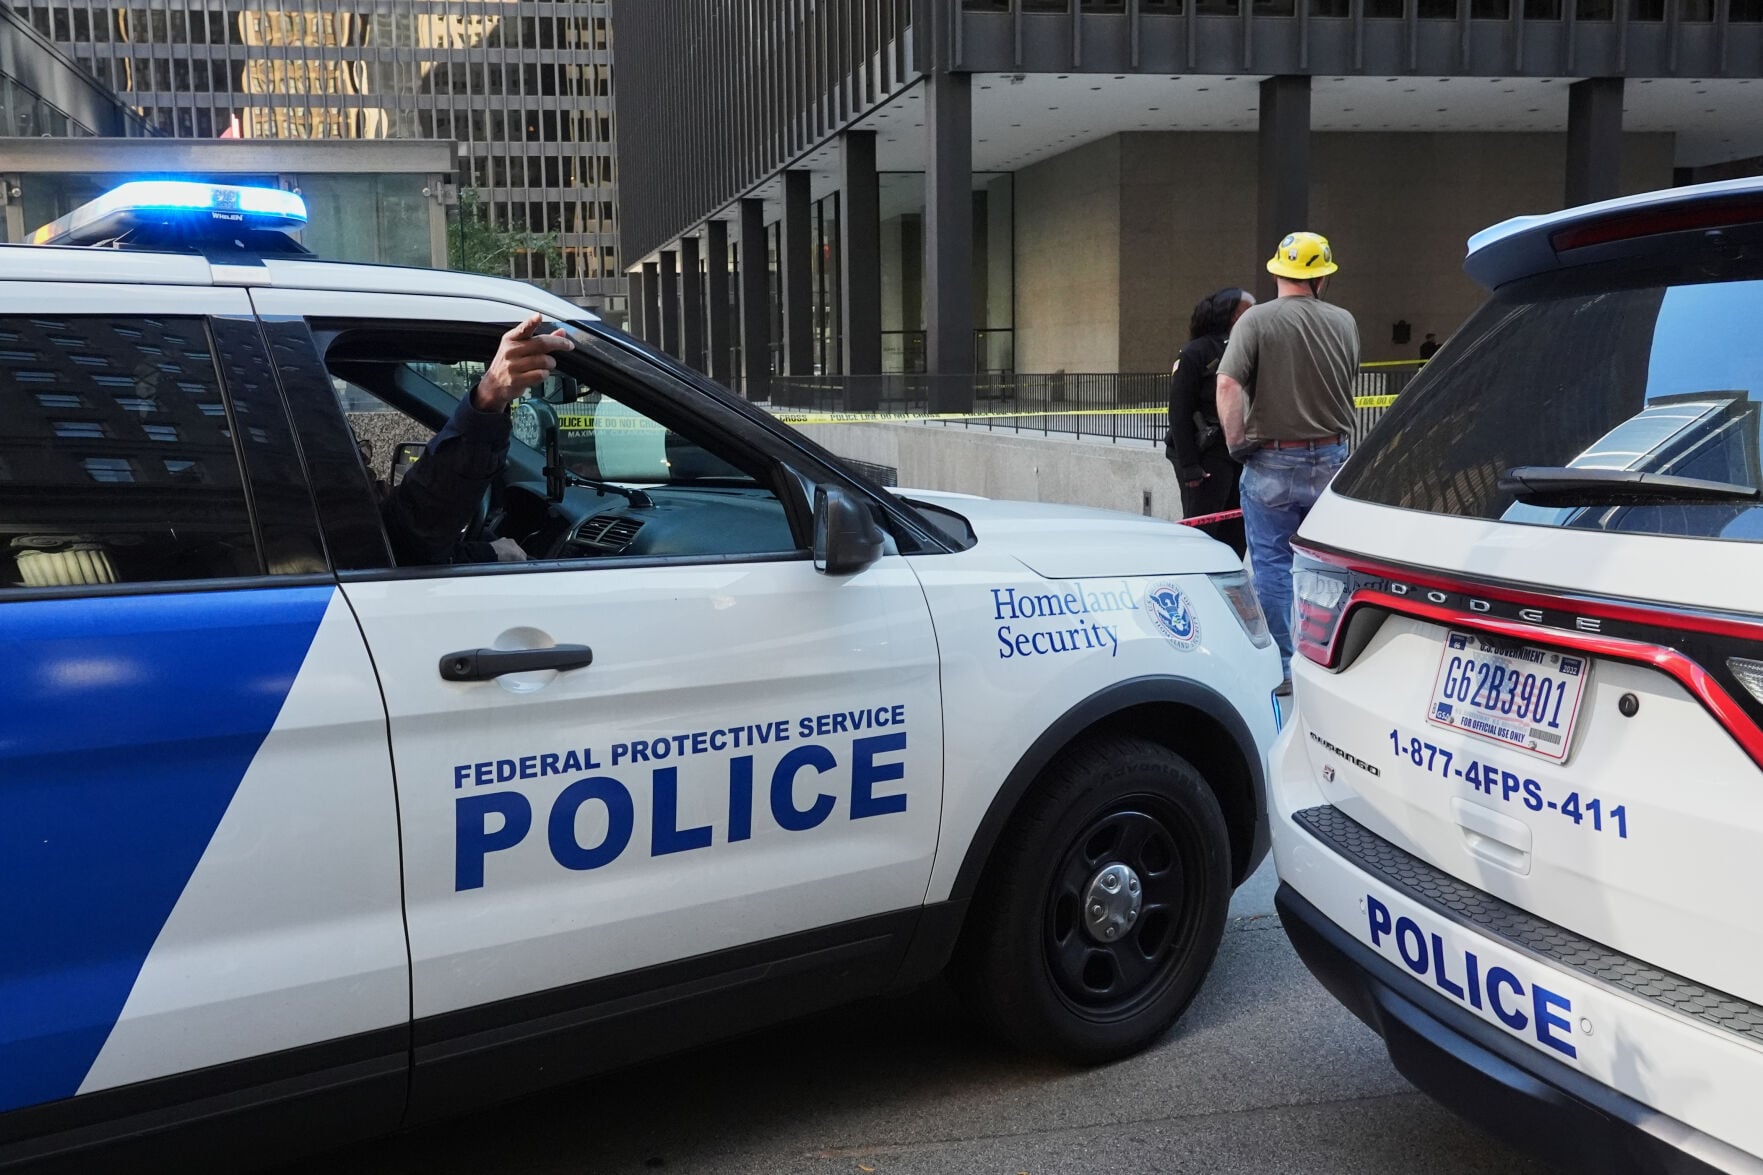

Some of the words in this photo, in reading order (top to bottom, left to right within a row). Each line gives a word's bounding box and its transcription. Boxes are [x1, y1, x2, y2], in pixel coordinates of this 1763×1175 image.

[559, 417, 582, 428] OLICE
[584, 417, 603, 428] LINE
[605, 417, 617, 428] DO
[619, 417, 637, 428] NOT
[990, 581, 1139, 620] Homeland
[1391, 582, 1602, 633] DODGE
[997, 619, 1118, 659] Security
[1494, 645, 1546, 664] GOVERNMENT
[1443, 656, 1567, 729] G62B3901
[454, 747, 600, 789] FEDERAL
[611, 720, 790, 767] PROTECTIVE
[798, 704, 906, 738] SERVICE
[1461, 716, 1472, 728] FOR
[1472, 720, 1497, 736] OFFICIAL
[1497, 727, 1509, 739] USE
[1510, 730, 1526, 743] ONLY
[1389, 728, 1629, 840] 1-877-4FPS-411
[454, 731, 907, 892] POLICE
[1366, 894, 1579, 1061] POLICE
